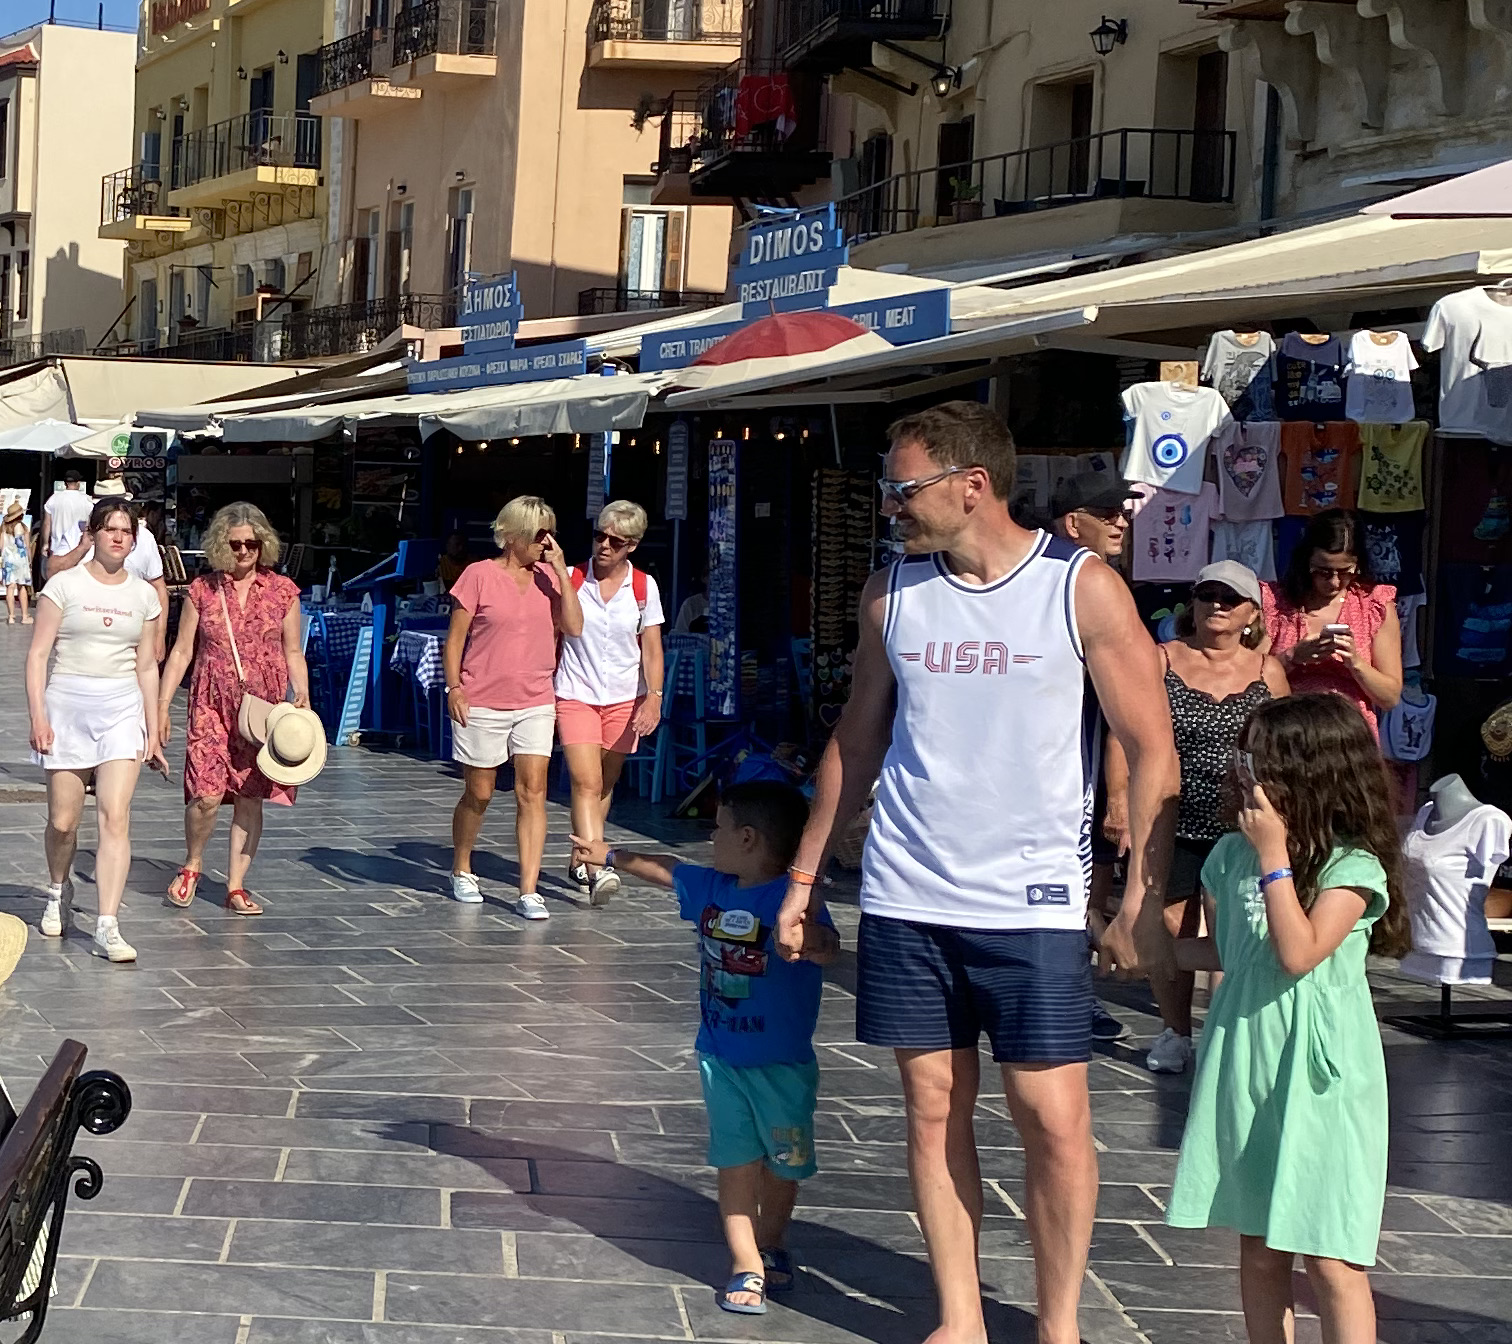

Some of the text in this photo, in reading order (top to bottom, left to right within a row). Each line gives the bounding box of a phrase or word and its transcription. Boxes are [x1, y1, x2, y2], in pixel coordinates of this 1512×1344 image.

[749, 220, 823, 265] DIMOS
[462, 283, 513, 316] ΔΗΜΟΣ
[741, 269, 827, 304] RESTAURANT
[462, 320, 511, 343] ΕΣΤΙΑΤΟΡΙΟ
[659, 340, 686, 359] CRETA
[885, 305, 917, 329] MEAT
[108, 456, 166, 469] GYROS
[82, 605, 133, 617] Switzerland
[925, 641, 1009, 675] USA
